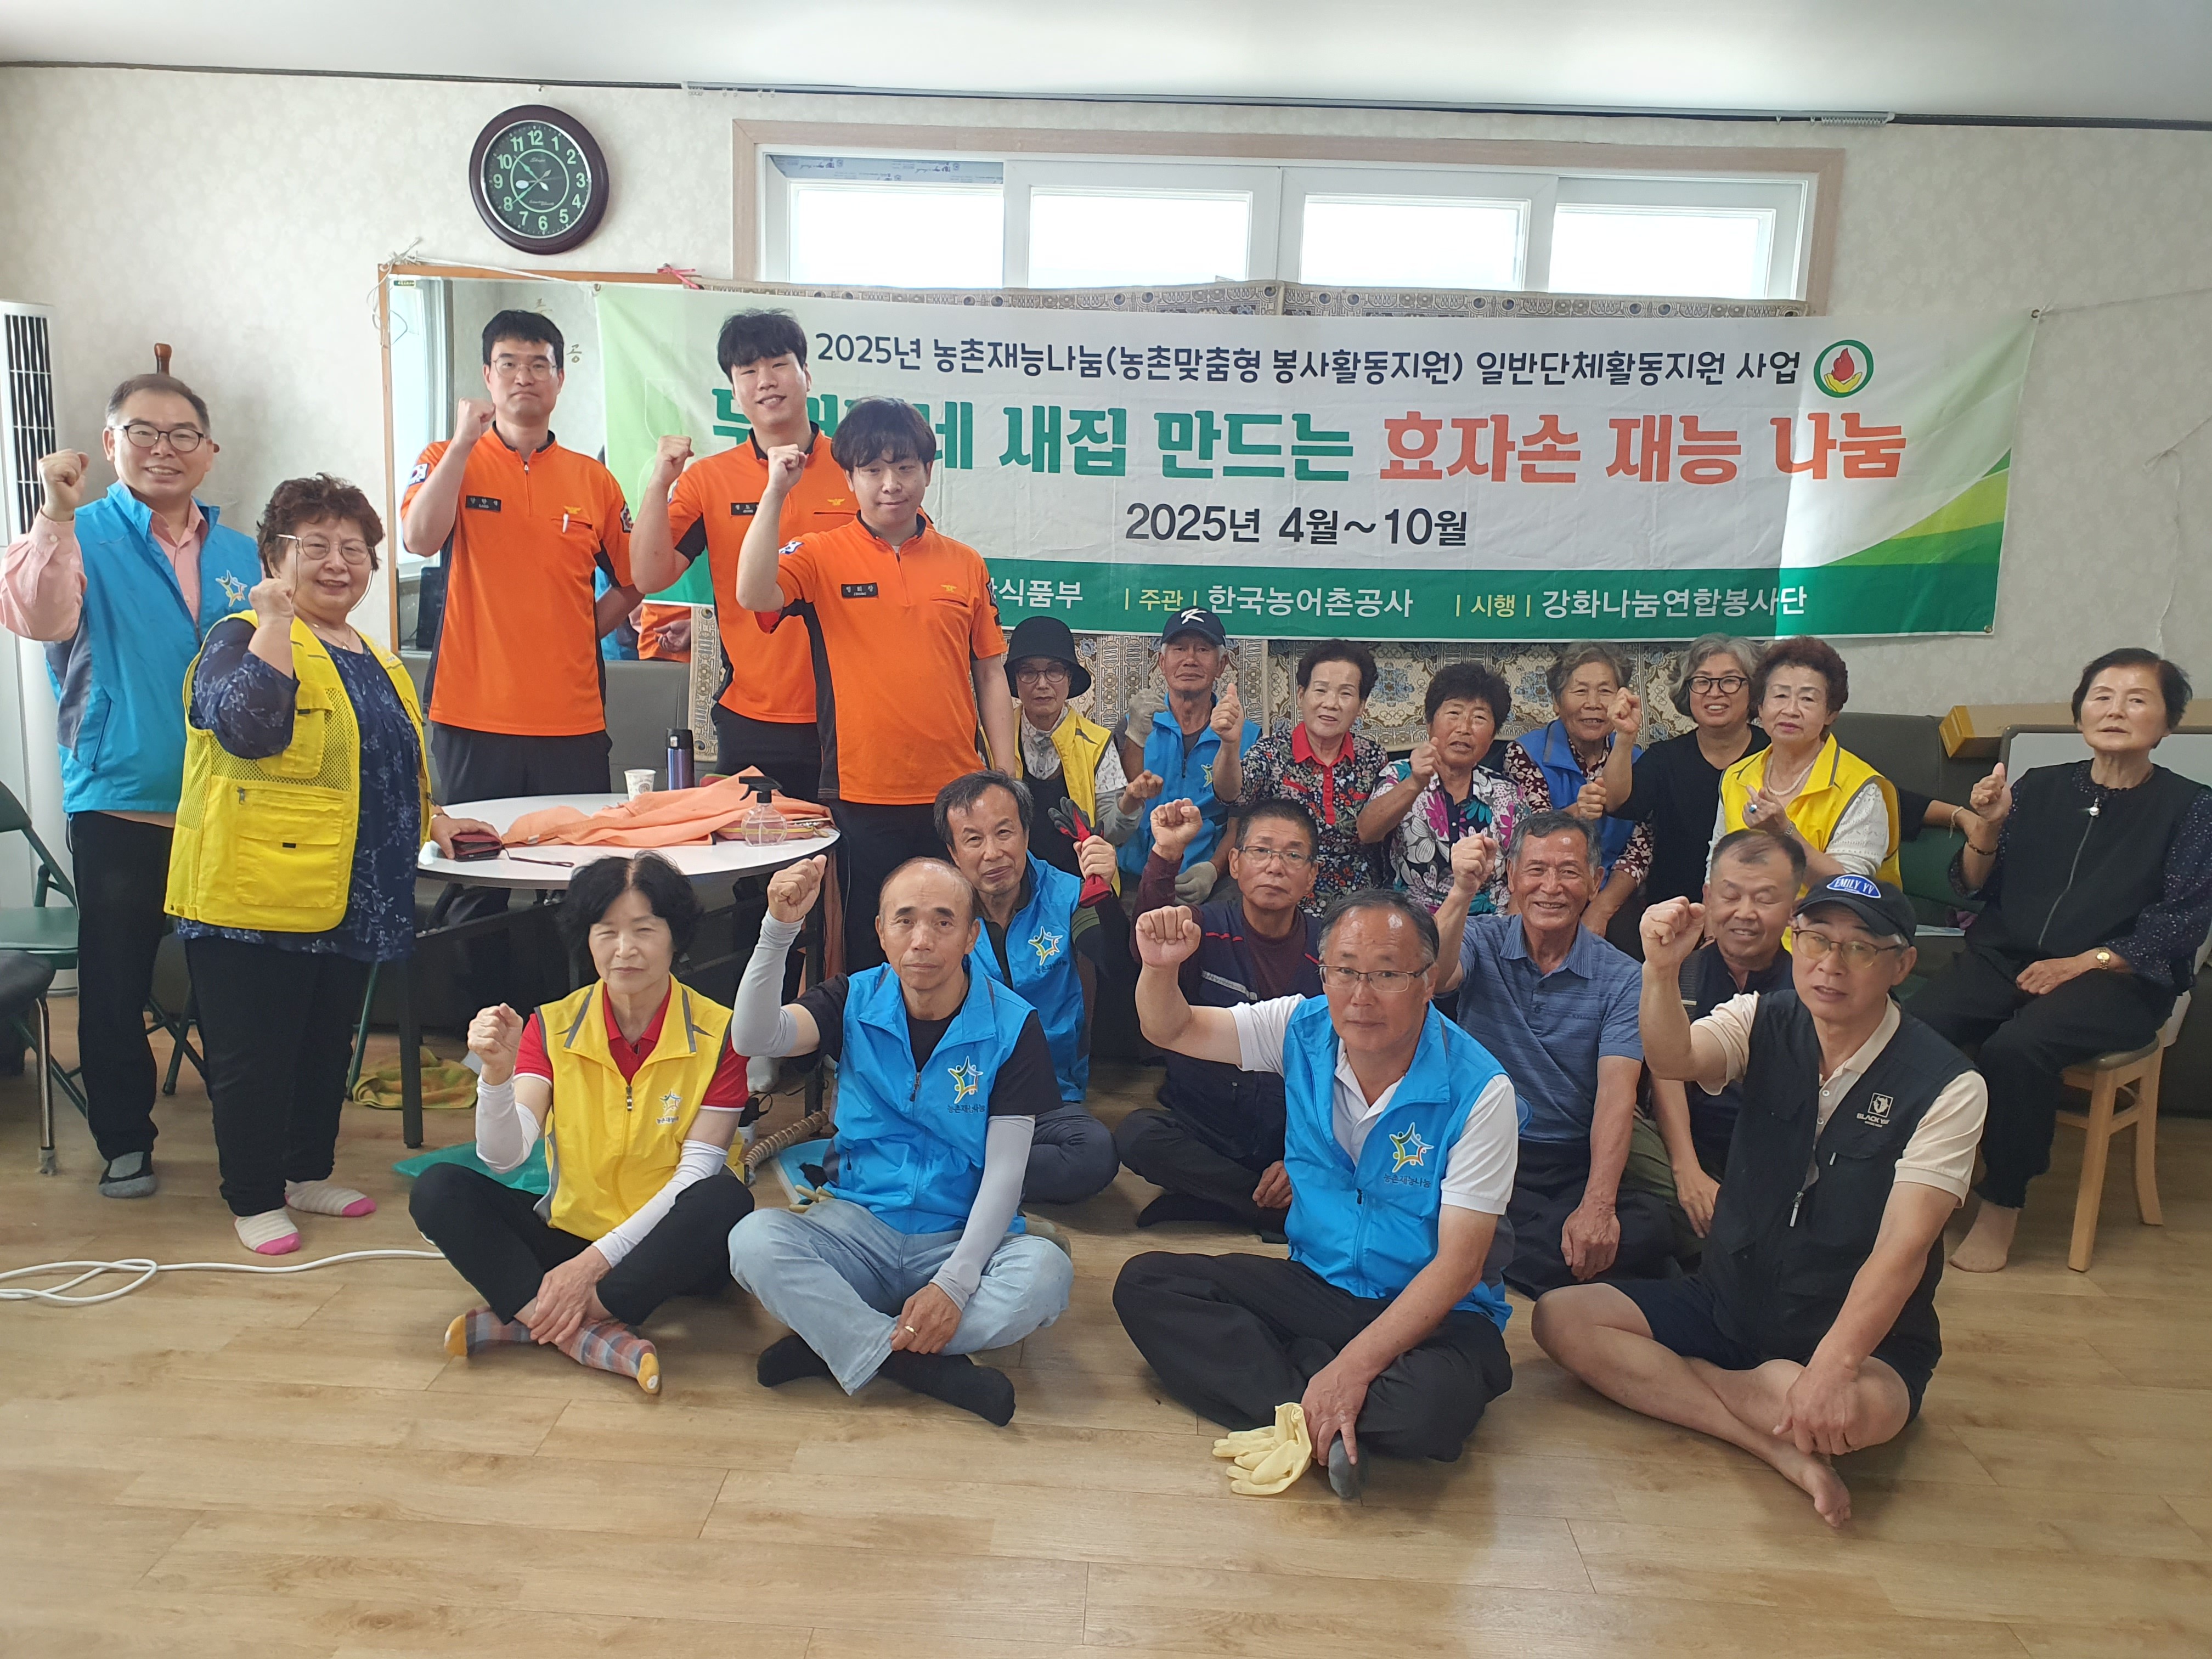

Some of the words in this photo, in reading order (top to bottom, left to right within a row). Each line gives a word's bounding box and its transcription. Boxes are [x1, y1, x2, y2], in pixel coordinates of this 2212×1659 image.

[510, 136, 524, 152] 11
[527, 130, 544, 145] 12
[551, 136, 559, 151] 1
[496, 154, 512, 170] 10
[567, 149, 577, 164] 2
[494, 173, 503, 189] 9
[576, 172, 586, 188] 3
[503, 196, 513, 212] 8
[572, 194, 582, 208] 4
[519, 211, 529, 226] 7
[538, 215, 548, 230] 6
[559, 208, 569, 224] 5
[815, 332, 921, 371] 2025년
[933, 338, 1261, 383] 농촌재능나눔(농촌맞춤형
[1273, 348, 1463, 385] 봉사활동지원)
[1476, 350, 1725, 386] 일반단체활동지원
[1736, 351, 1801, 385] 사업
[998, 405, 1128, 477] 새집
[1153, 410, 1355, 482] 만드는
[1379, 410, 1582, 484] 효자손
[1605, 414, 1742, 485] 재능
[1769, 412, 1907, 480] 나눔
[1125, 502, 1261, 543] 2025년
[1138, 589, 1183, 612] 주관
[1207, 584, 1414, 618] 한국농어촌공사
[1470, 594, 1516, 618] 시행
[1541, 585, 1808, 619] 강화나눔연합봉사단
[1833, 878, 1861, 890] EMILY
